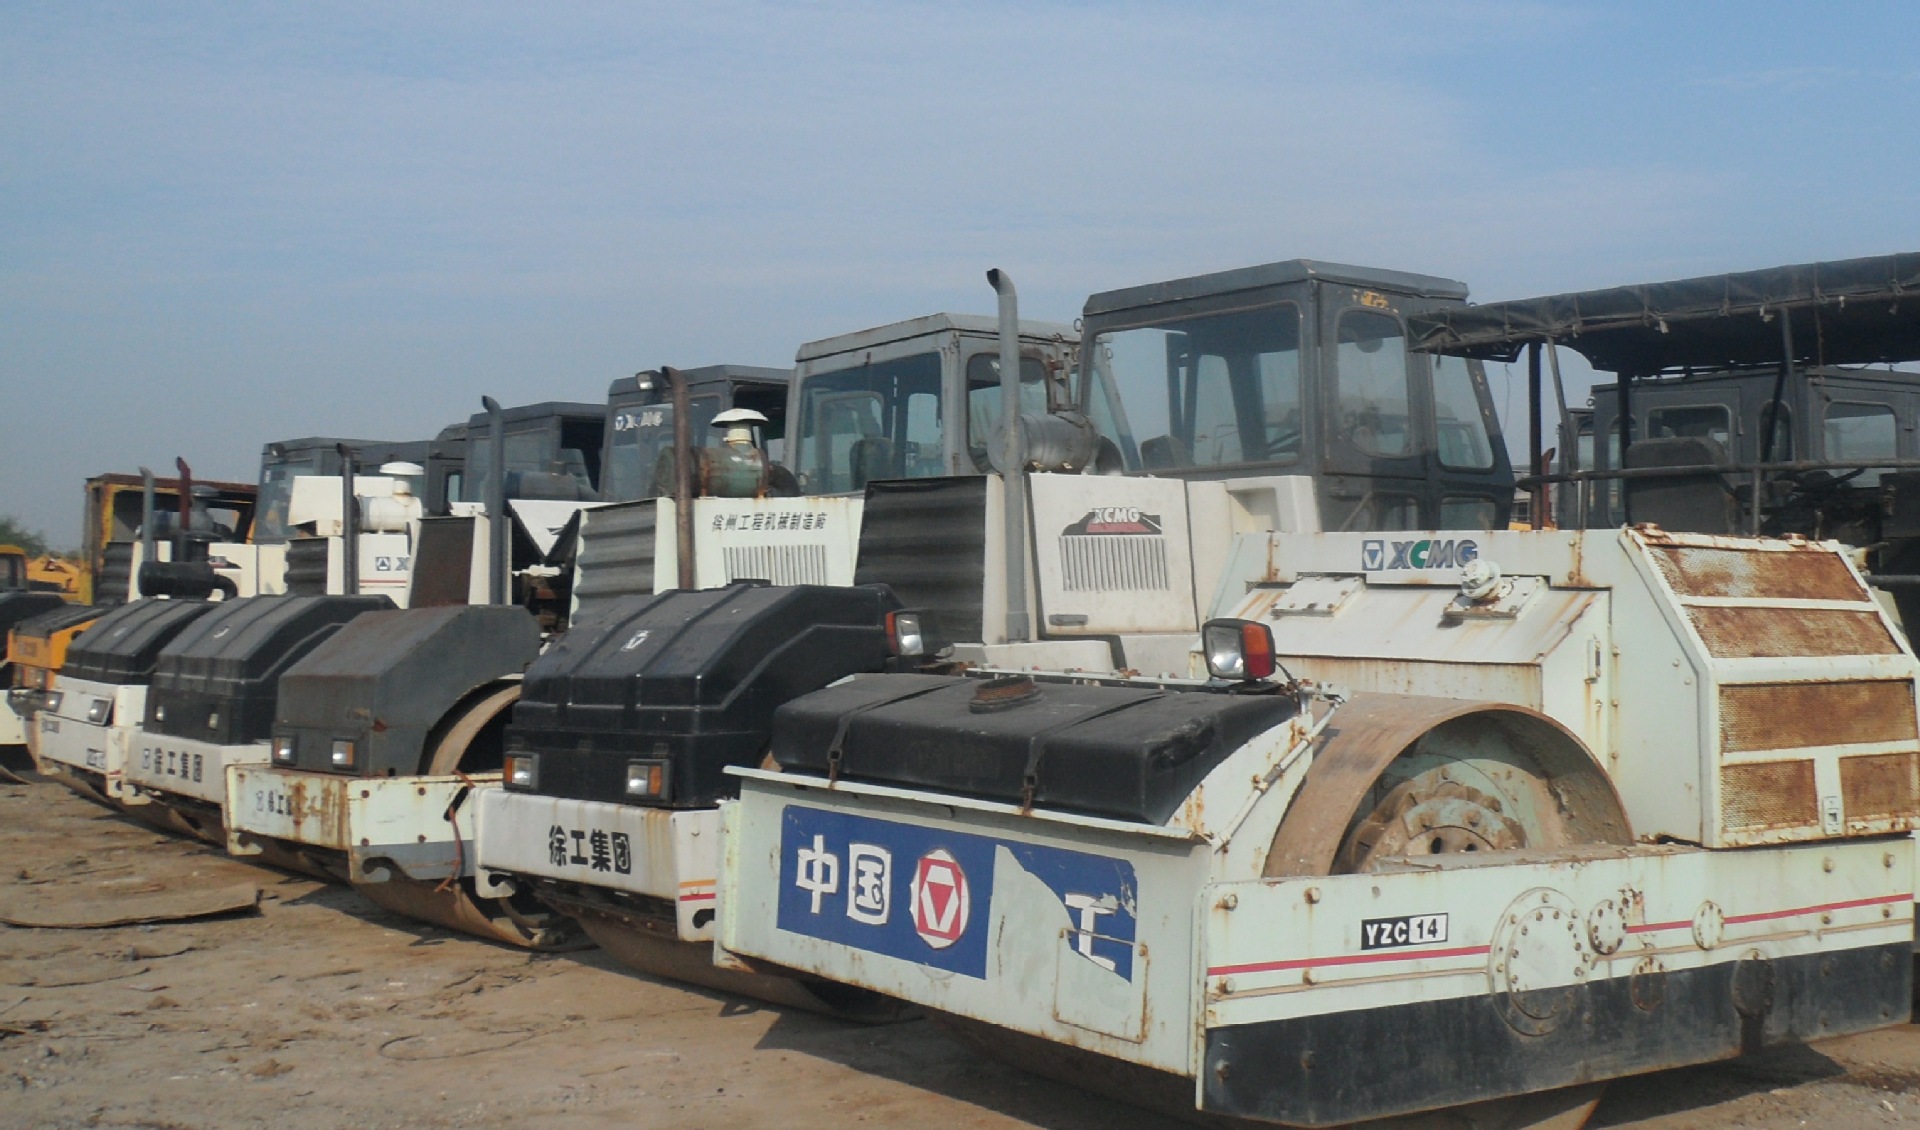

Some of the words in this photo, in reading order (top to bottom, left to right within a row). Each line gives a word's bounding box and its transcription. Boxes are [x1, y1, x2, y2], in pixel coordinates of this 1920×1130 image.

[1091, 507, 1141, 524] XCMG
[1386, 539, 1478, 570] XCMG
[548, 824, 632, 875] 徐工集团
[795, 834, 892, 926] 中国
